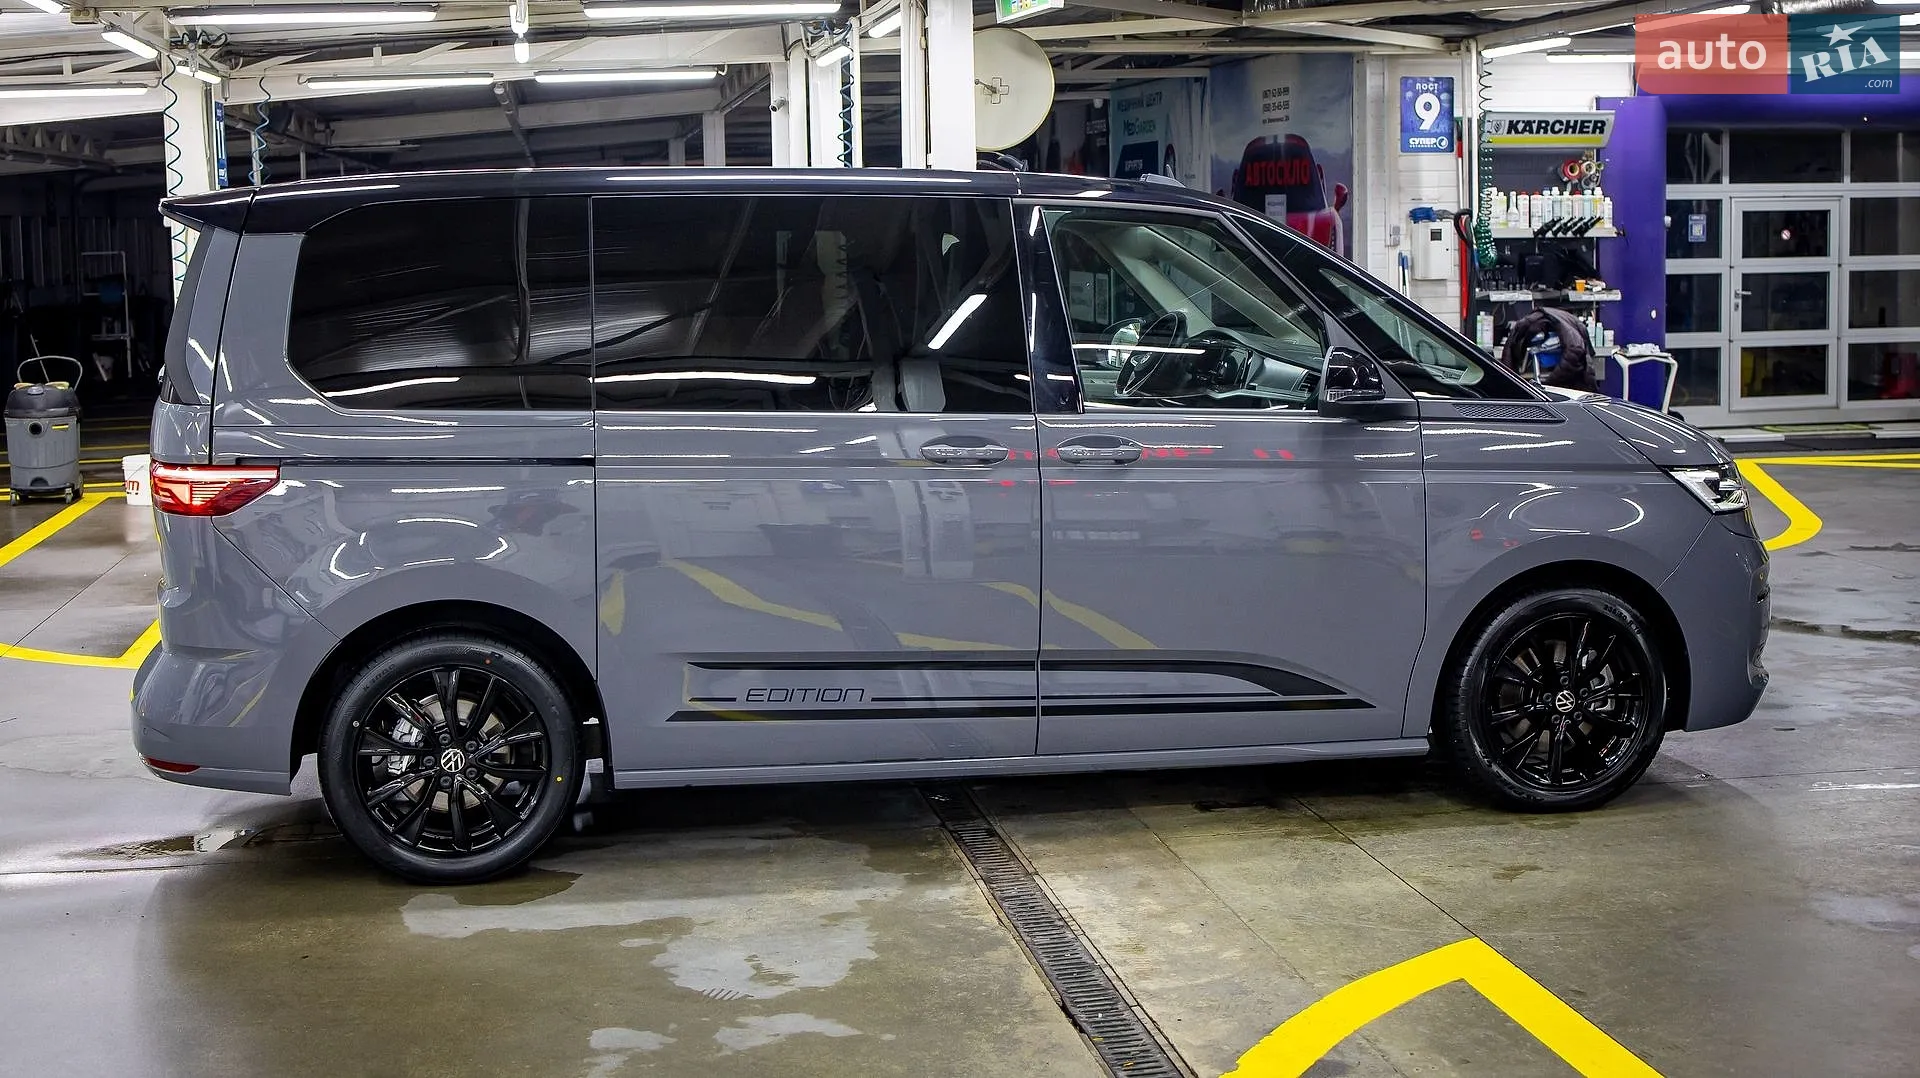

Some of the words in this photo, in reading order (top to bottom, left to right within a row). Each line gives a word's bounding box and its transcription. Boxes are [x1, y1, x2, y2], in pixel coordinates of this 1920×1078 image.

[1415, 92, 1440, 130] 9
[1506, 119, 1607, 135] KÄRCHER
[1409, 137, 1437, 145] СУПЕР
[1245, 158, 1310, 186] АВТОСКЛО
[745, 687, 865, 703] EDITION
